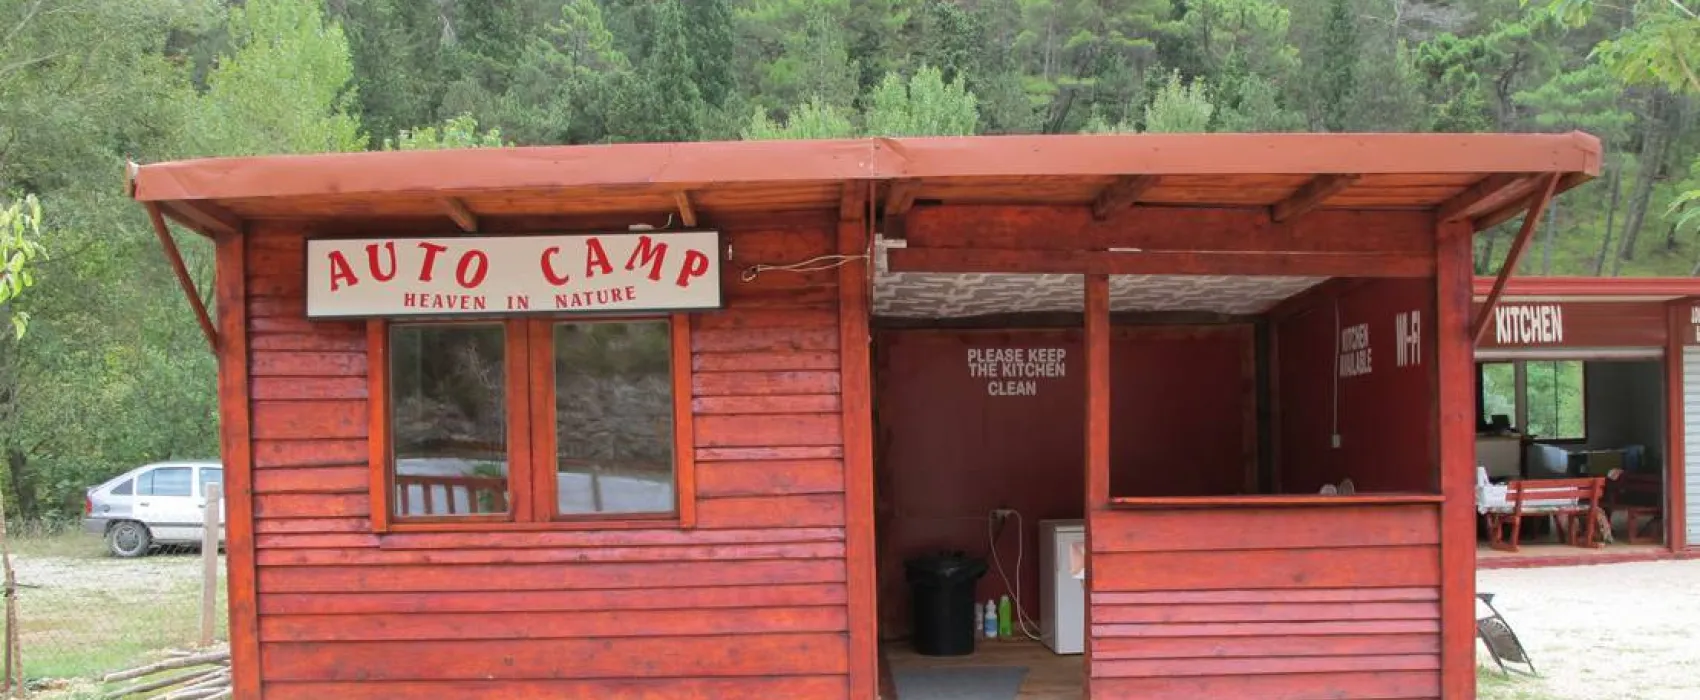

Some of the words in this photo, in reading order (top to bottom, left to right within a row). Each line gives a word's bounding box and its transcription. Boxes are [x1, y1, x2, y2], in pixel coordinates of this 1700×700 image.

[328, 241, 488, 292] AUTO
[540, 235, 710, 287] CAMP
[404, 292, 487, 310] HEAVEN
[507, 296, 529, 309] IN
[555, 286, 637, 309] NATURE
[1495, 305, 1563, 344] KITCHEN
[967, 348, 1024, 362] PLEASE
[1028, 348, 1067, 362] KEEP
[969, 362, 998, 377] THE
[1002, 362, 1065, 377] KITCHEN
[988, 381, 1037, 396] CLEAN
